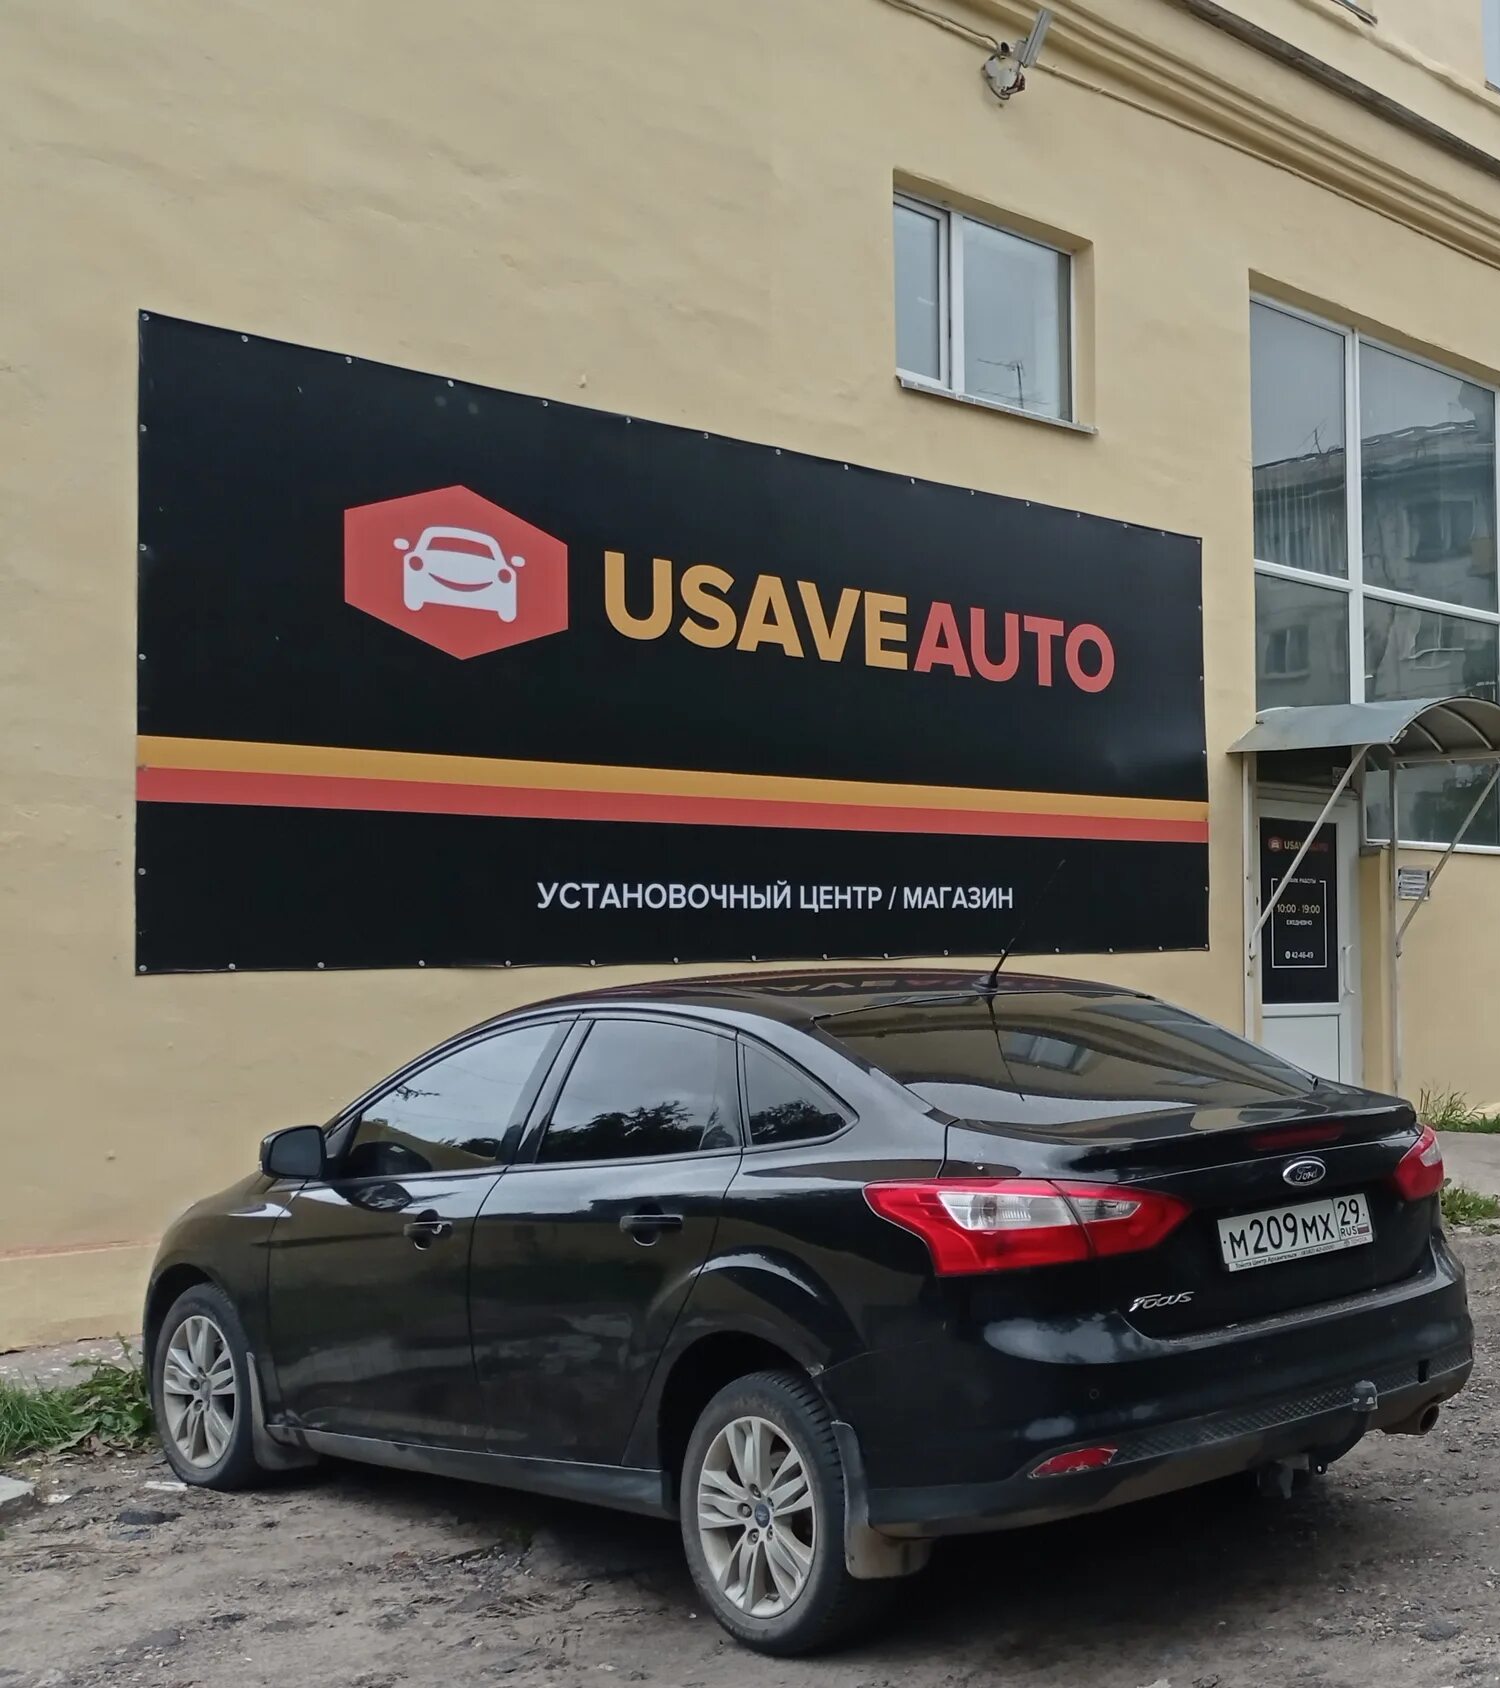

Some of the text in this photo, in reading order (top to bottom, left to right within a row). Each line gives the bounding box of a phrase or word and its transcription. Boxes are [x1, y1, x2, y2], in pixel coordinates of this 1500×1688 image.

[604, 551, 1115, 693] USAVEAUTO
[537, 880, 1013, 912] УСТАНОВОЧНЫЙ ЦЕНТР / МАГАЗИН
[1277, 904, 1296, 913] 10:00
[1302, 904, 1320, 914] 19:00
[1296, 1165, 1318, 1181] Ford
[1338, 1199, 1359, 1226] 29
[1340, 1226, 1358, 1237] RUS
